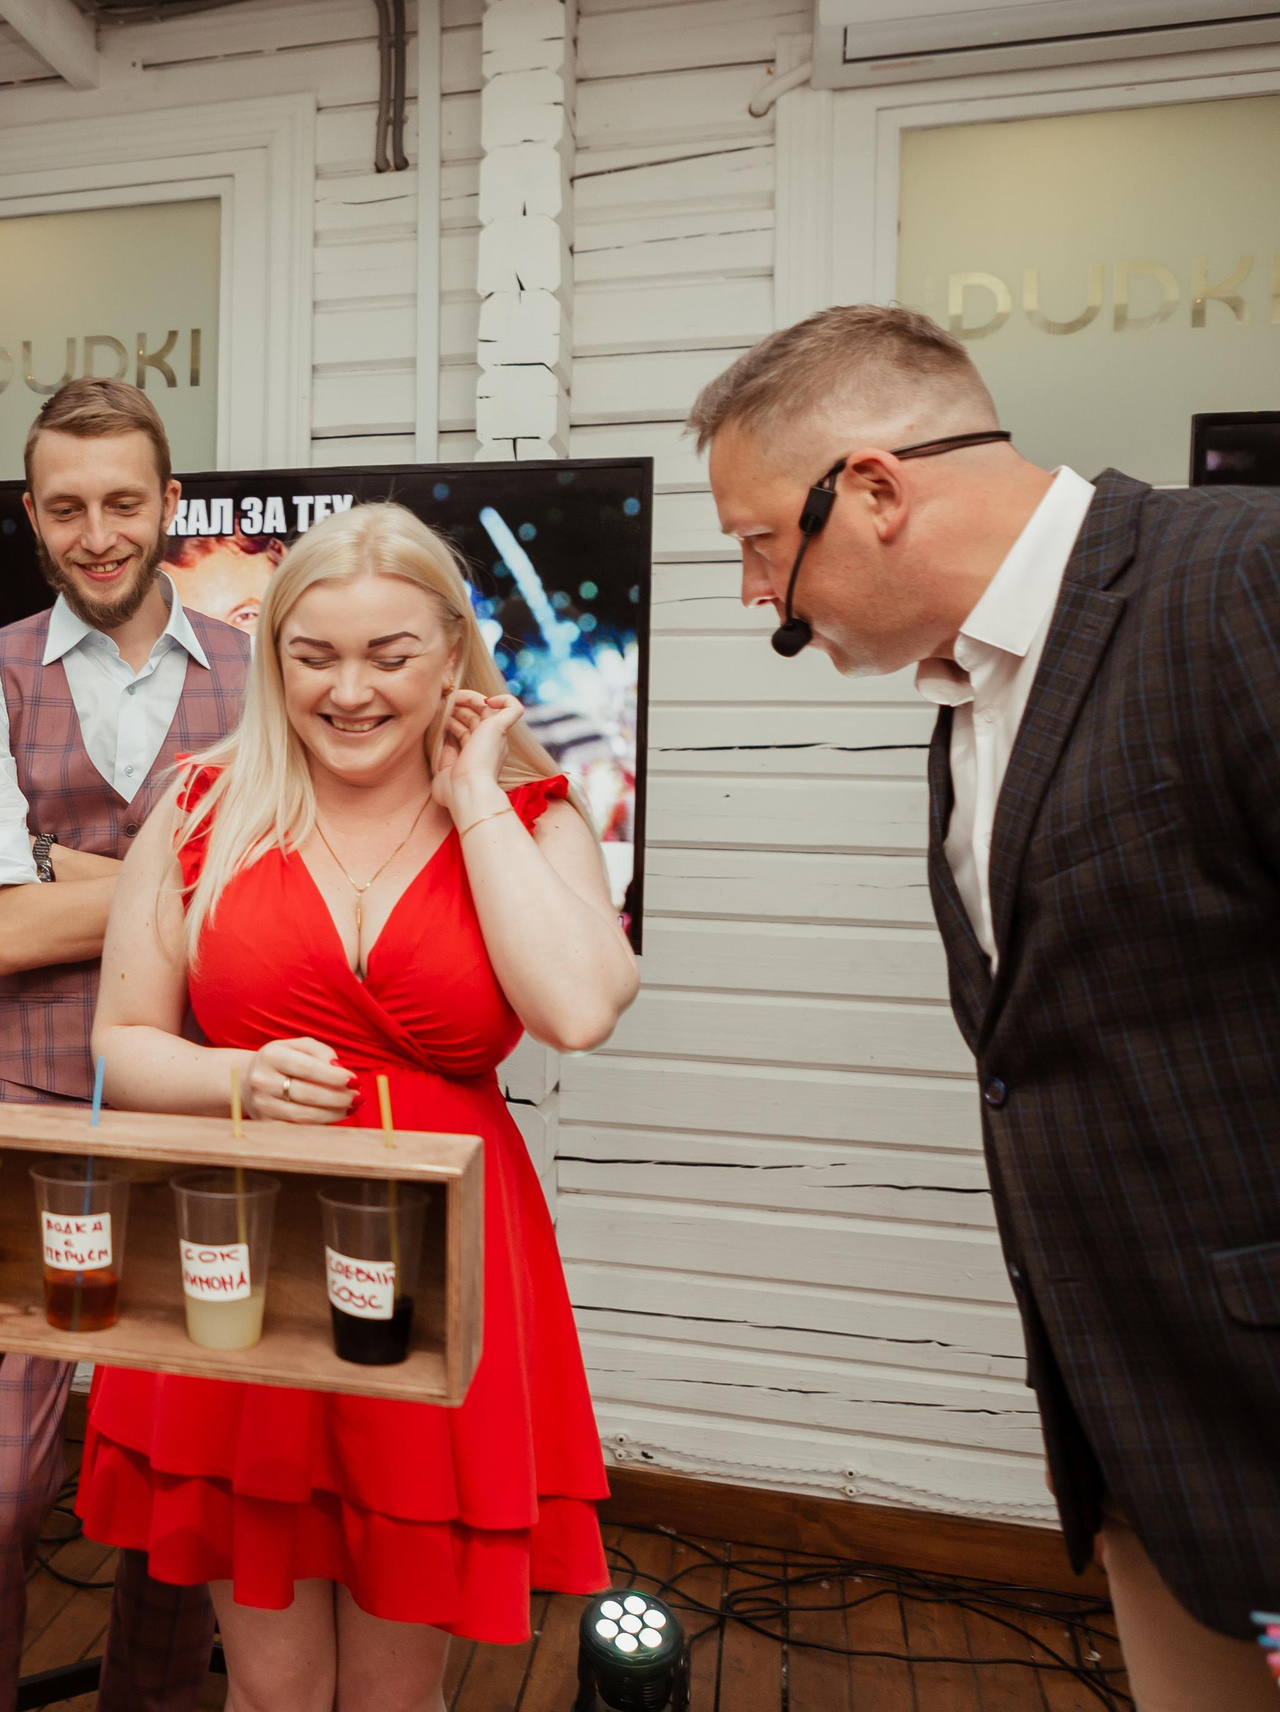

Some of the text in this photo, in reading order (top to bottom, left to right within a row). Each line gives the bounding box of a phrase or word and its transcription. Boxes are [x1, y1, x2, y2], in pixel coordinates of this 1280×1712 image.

[241, 496, 288, 534] ЗА
[46, 1219, 103, 1235] ВОДКА
[185, 1248, 240, 1263] СОК
[331, 1280, 384, 1309] СОУС
